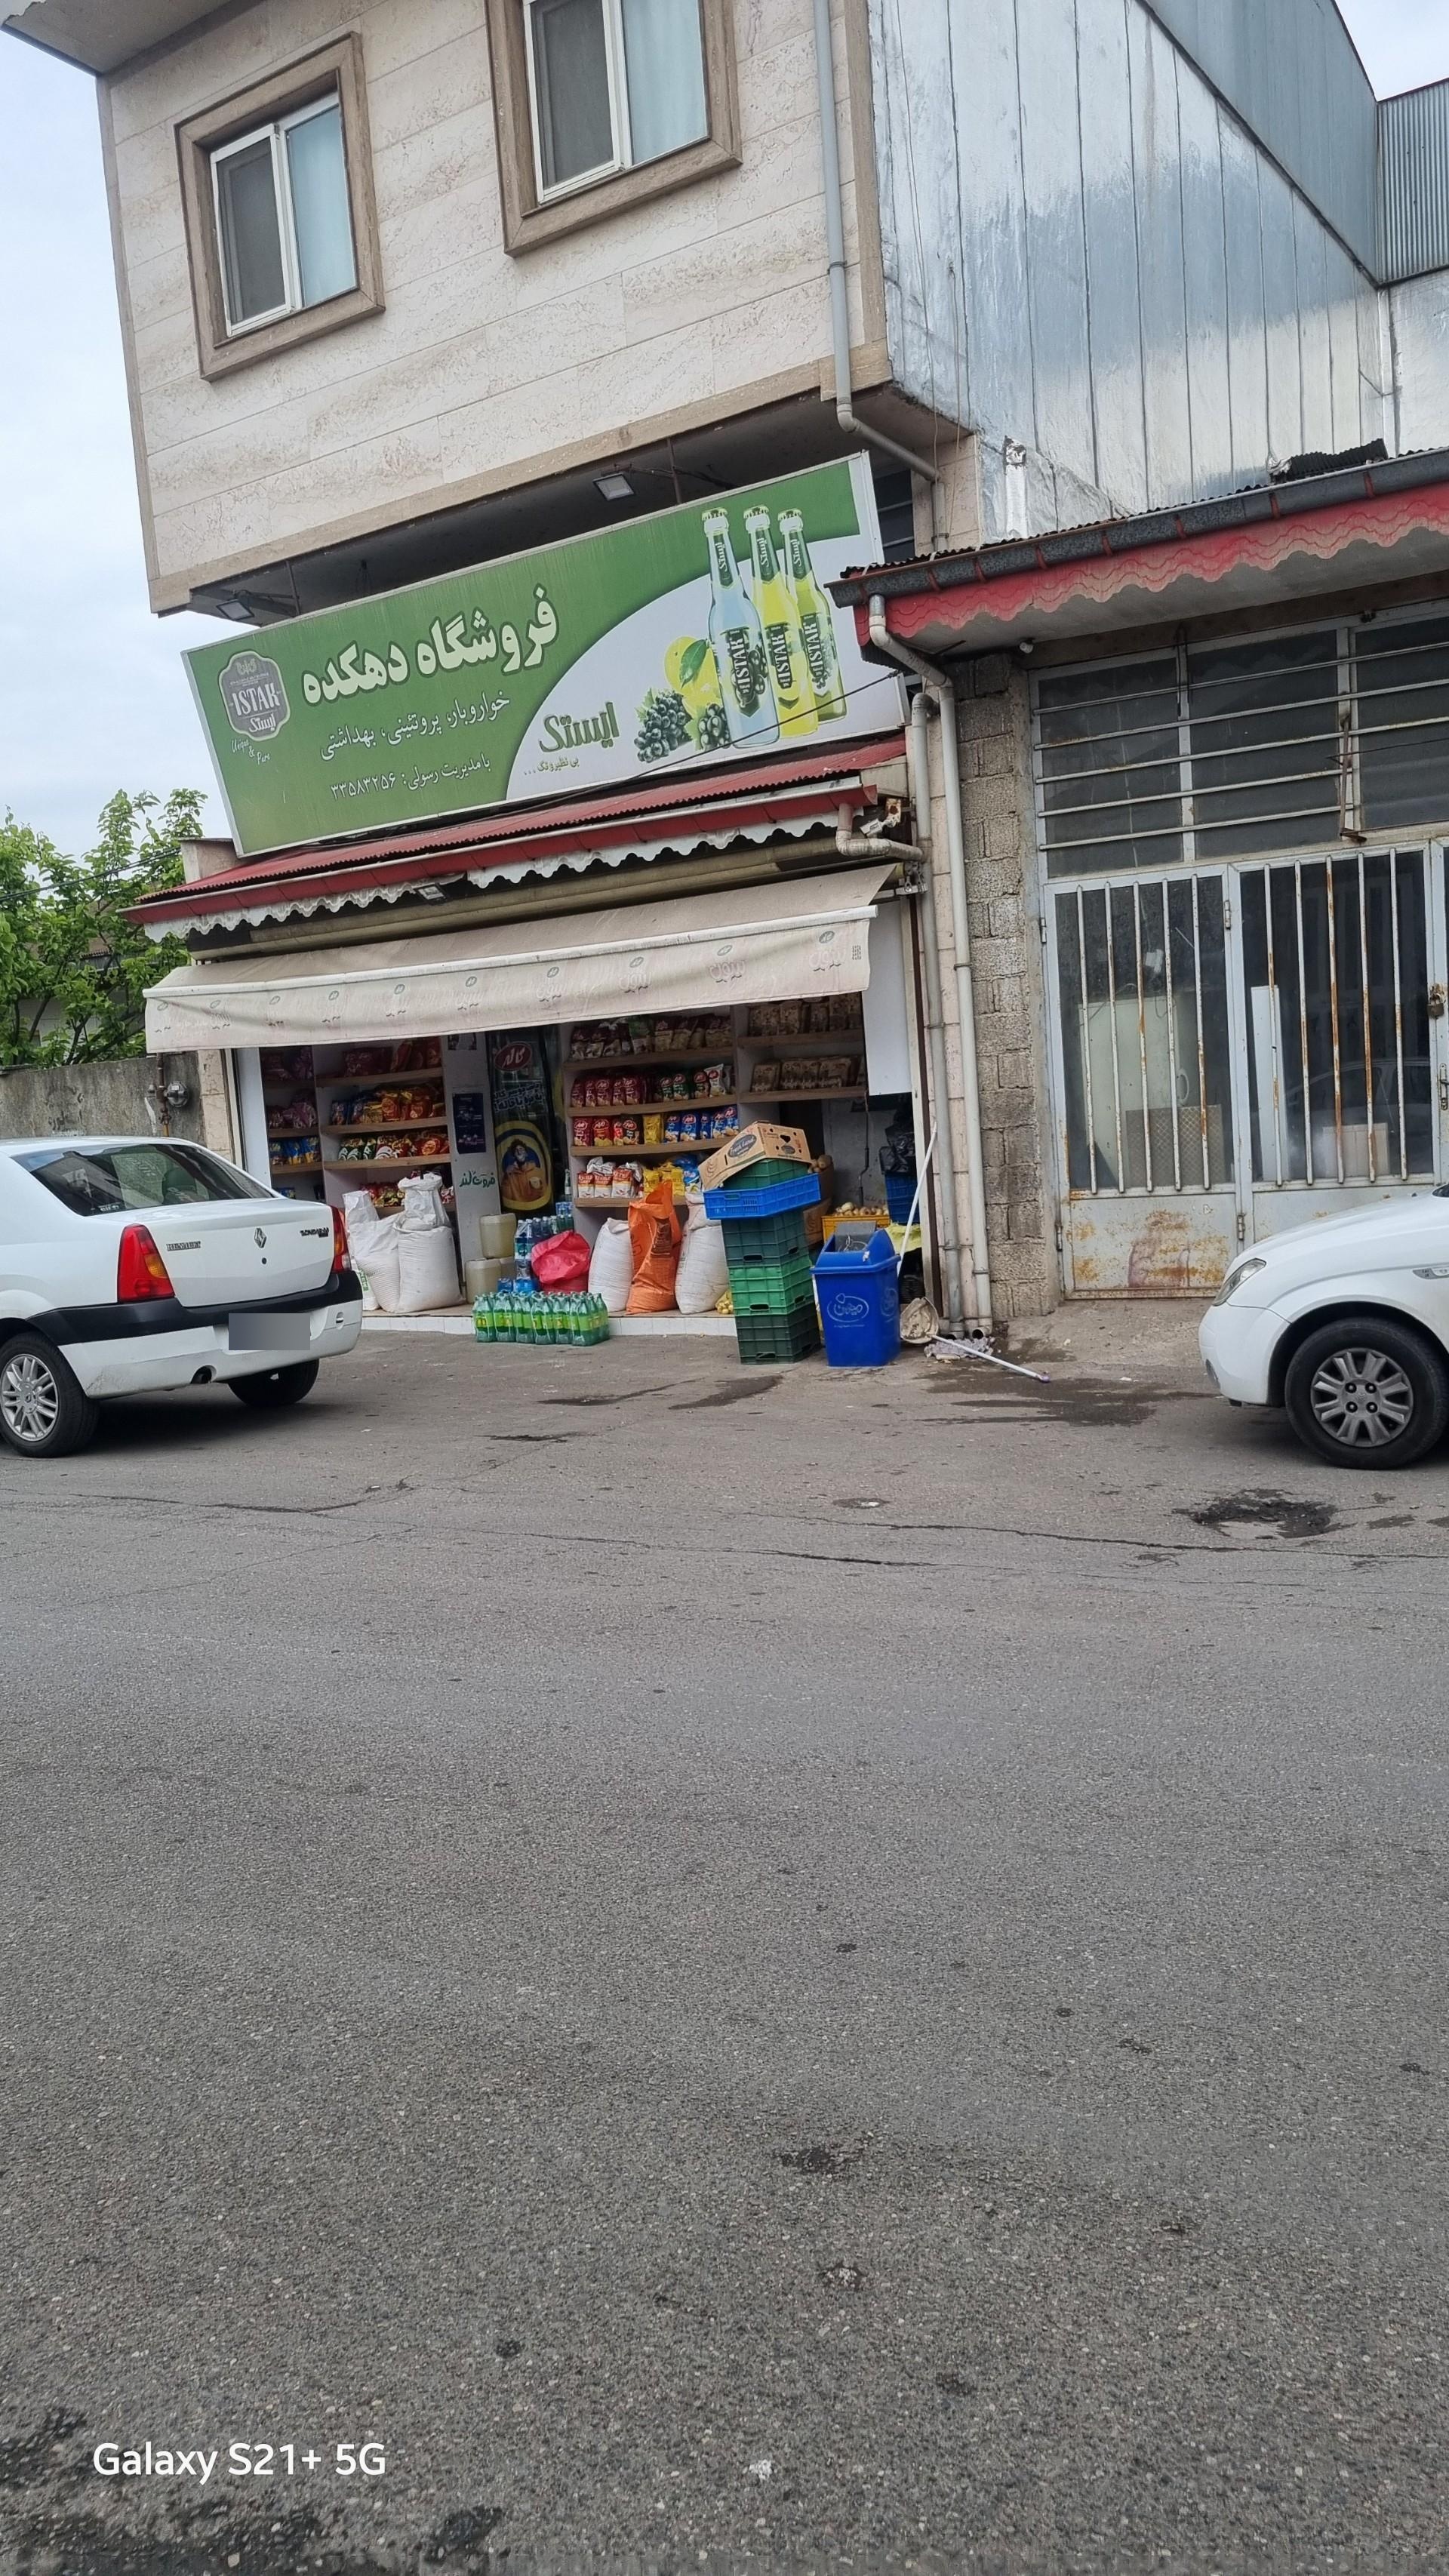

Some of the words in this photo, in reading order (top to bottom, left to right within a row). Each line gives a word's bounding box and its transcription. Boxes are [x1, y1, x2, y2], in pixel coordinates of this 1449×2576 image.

[416, 586, 558, 675] فروشگاه
[804, 623, 823, 667] ISTAK
[303, 642, 409, 704] دهکده
[730, 638, 750, 684] ISTAK
[771, 634, 791, 678] ISTAK
[232, 682, 281, 716] ISTAK
[248, 713, 276, 733] ایستک
[321, 725, 377, 761] بهداشتی
[539, 701, 620, 752] ایستک
[441, 758, 481, 780] مدیریت
[480, 753, 491, 771] با
